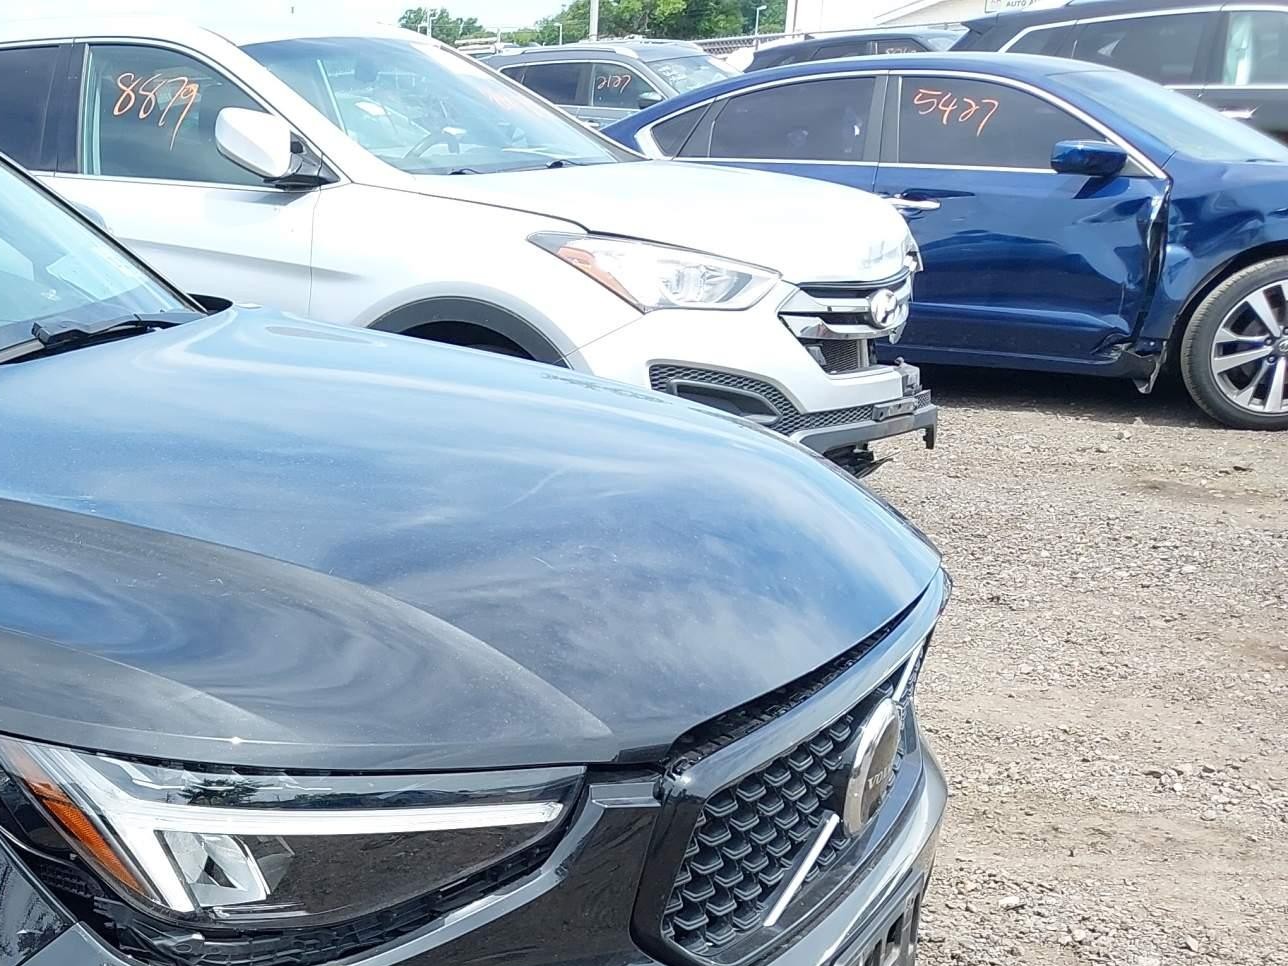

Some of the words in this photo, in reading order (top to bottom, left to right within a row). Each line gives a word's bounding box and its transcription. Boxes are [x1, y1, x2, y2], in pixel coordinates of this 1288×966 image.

[597, 74, 632, 95] 2127
[112, 72, 200, 152] 8879
[913, 87, 1000, 137] 5427
